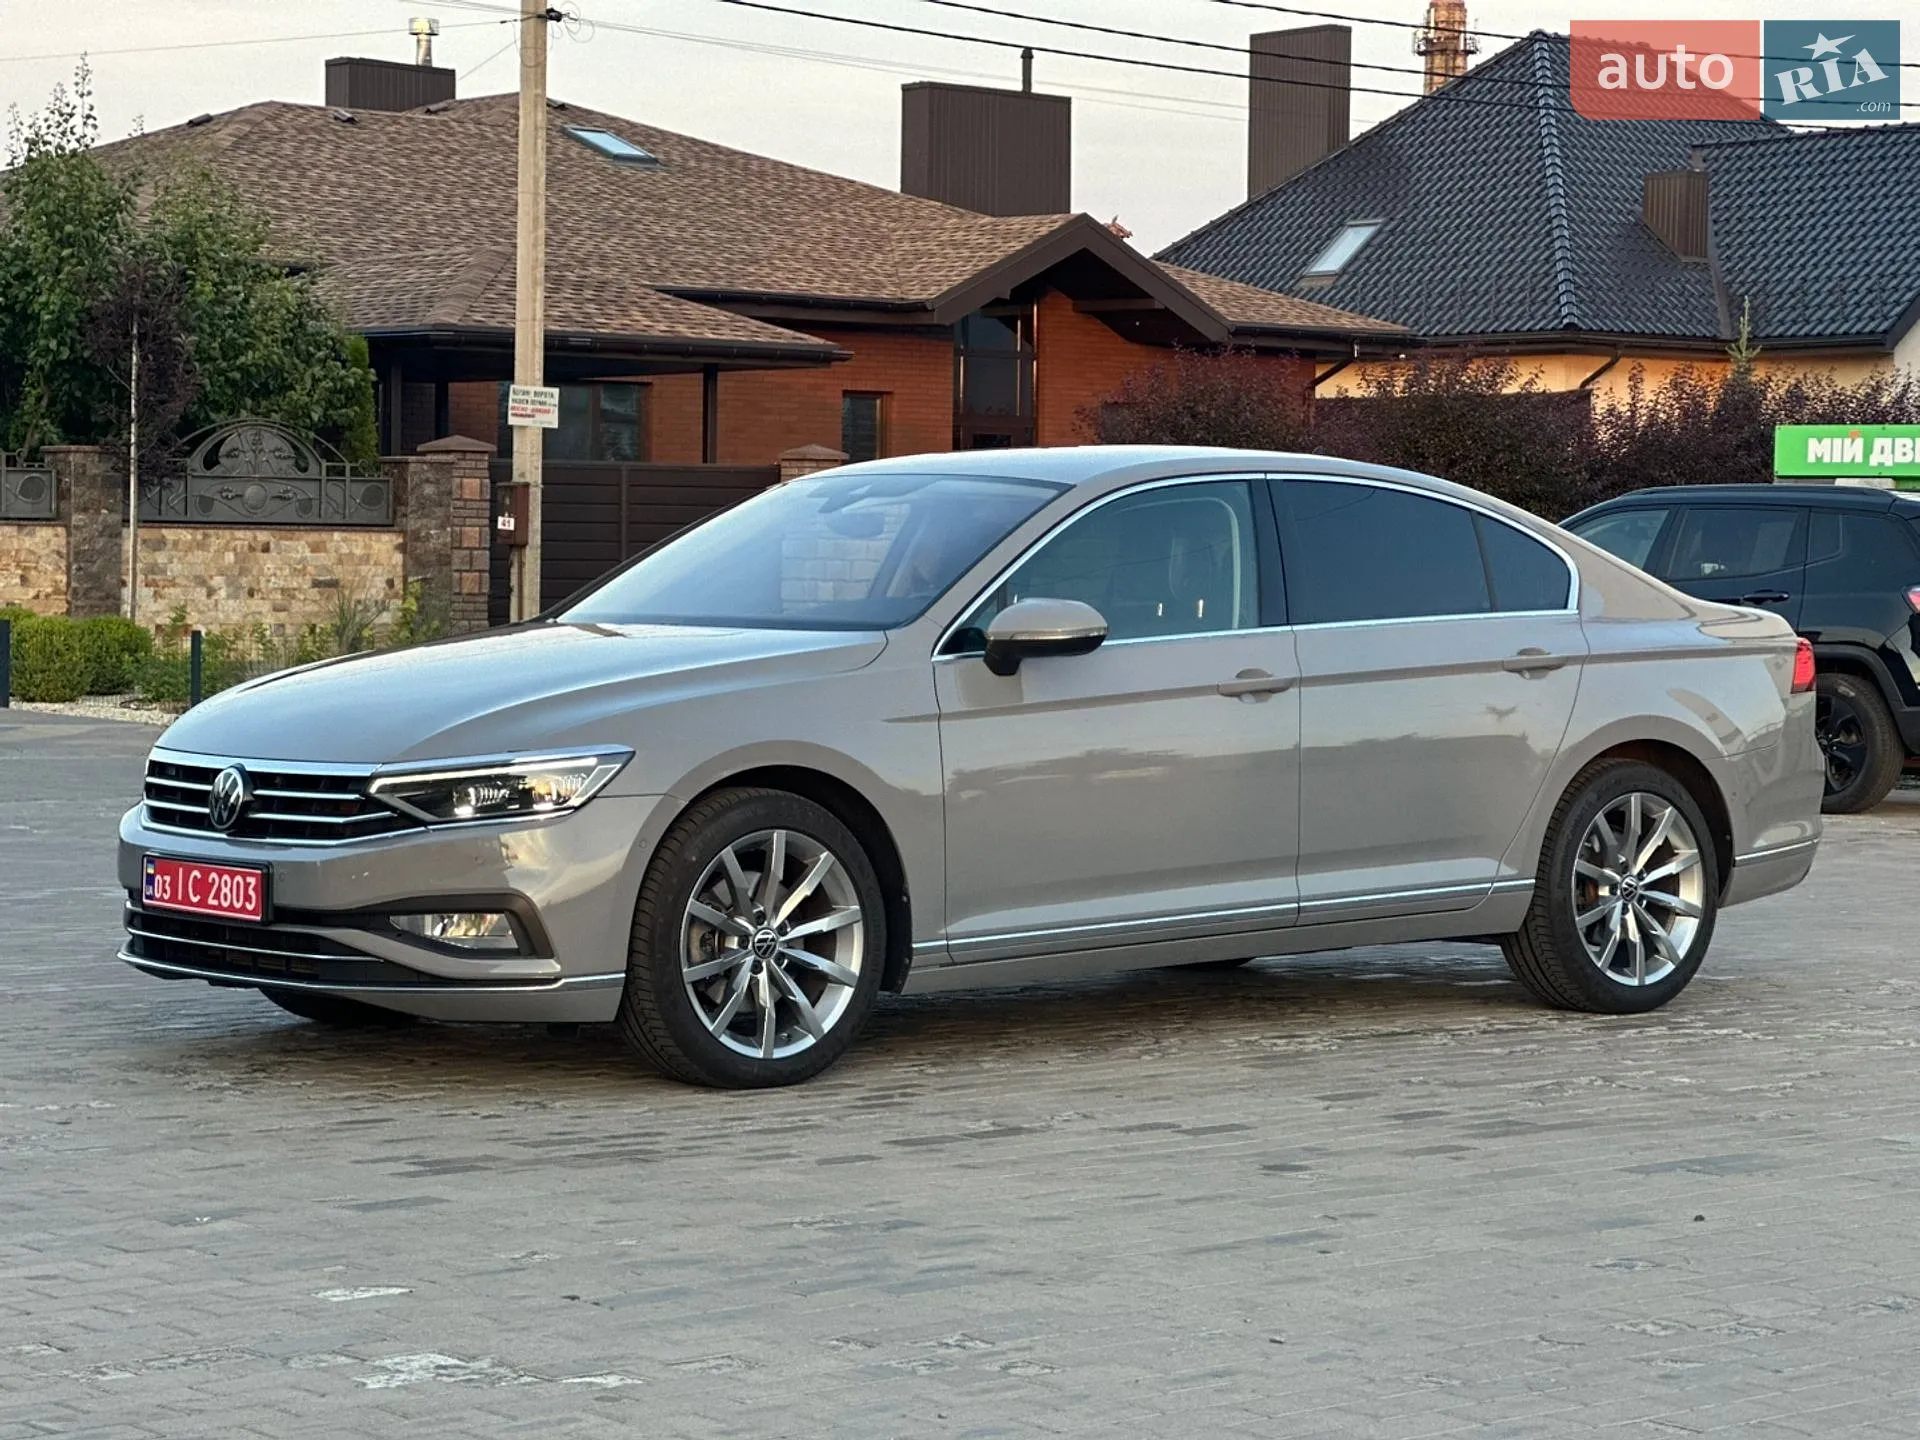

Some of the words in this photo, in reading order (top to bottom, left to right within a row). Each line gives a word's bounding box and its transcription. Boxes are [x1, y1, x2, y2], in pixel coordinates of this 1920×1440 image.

[1807, 430, 1865, 464] МІЙ
[154, 874, 171, 900] 03
[207, 871, 256, 911] 2803
